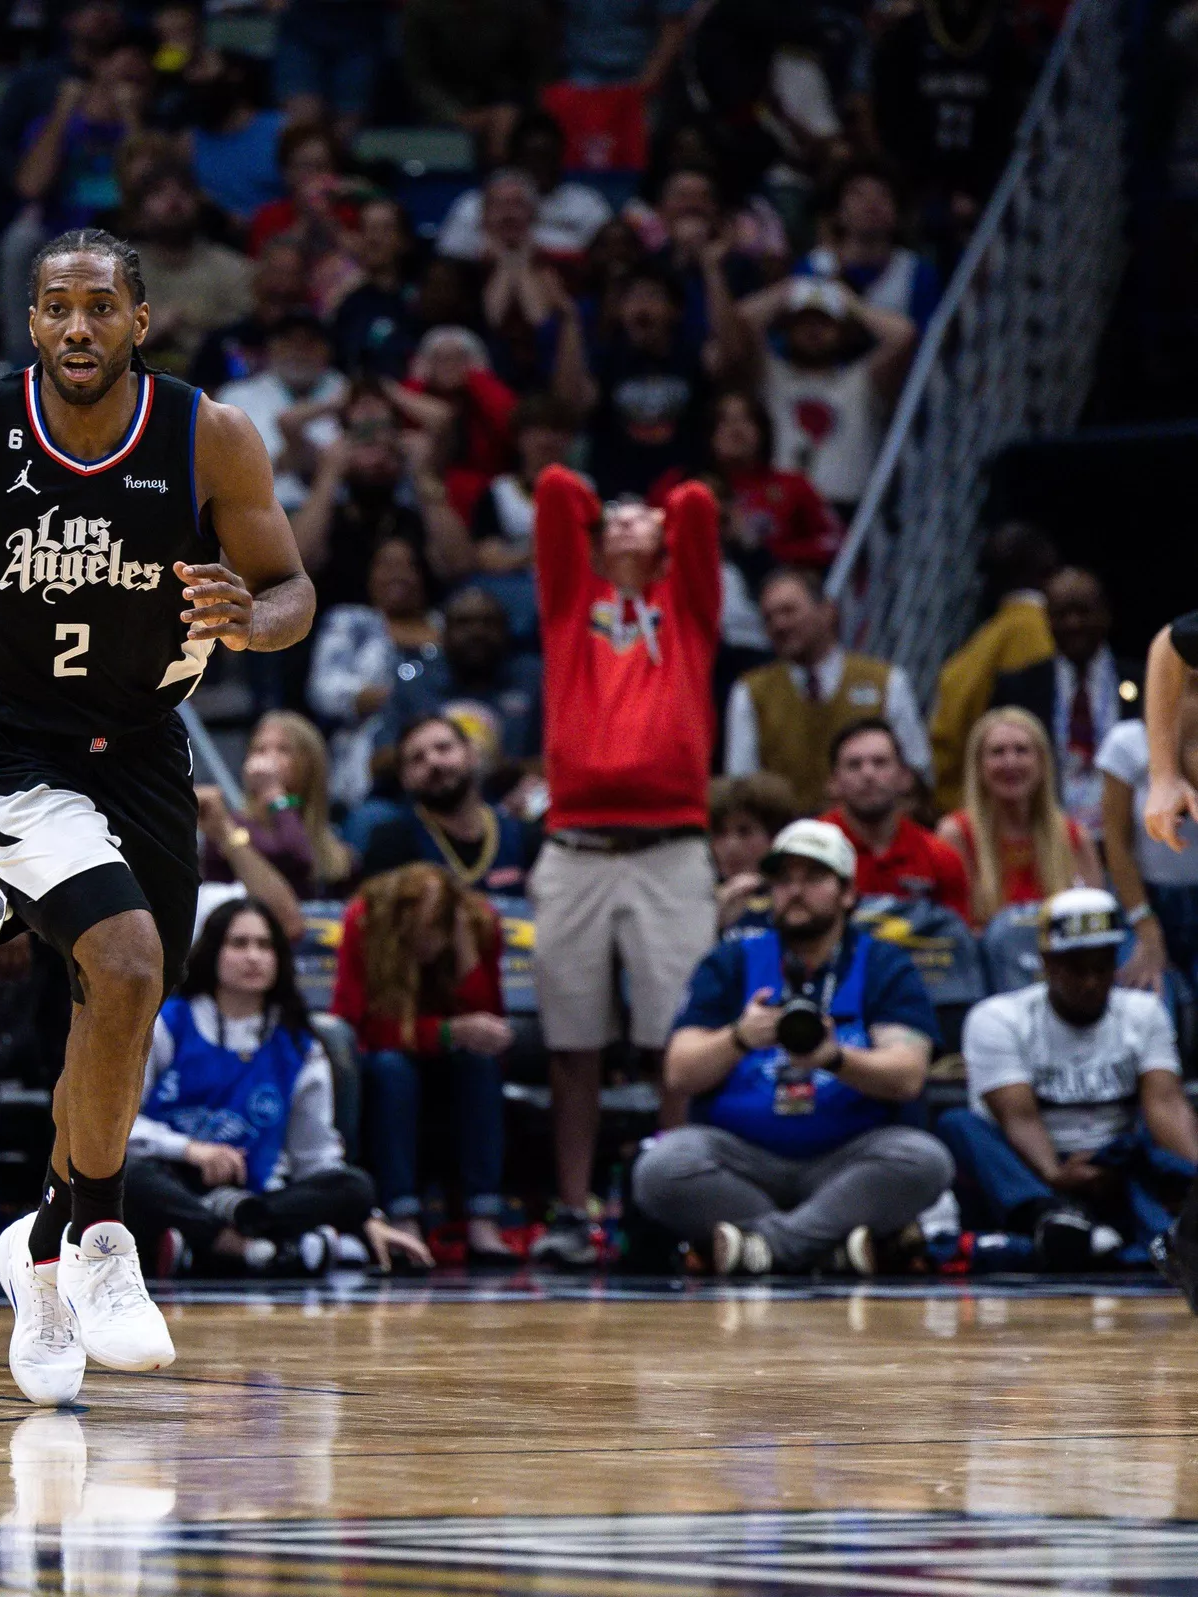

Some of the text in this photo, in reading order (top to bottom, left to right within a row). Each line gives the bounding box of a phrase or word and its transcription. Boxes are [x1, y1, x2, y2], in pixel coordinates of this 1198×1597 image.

[8, 428, 23, 450] 6
[123, 475, 169, 494] honey
[32, 504, 112, 554] Los
[53, 623, 90, 678] 2
